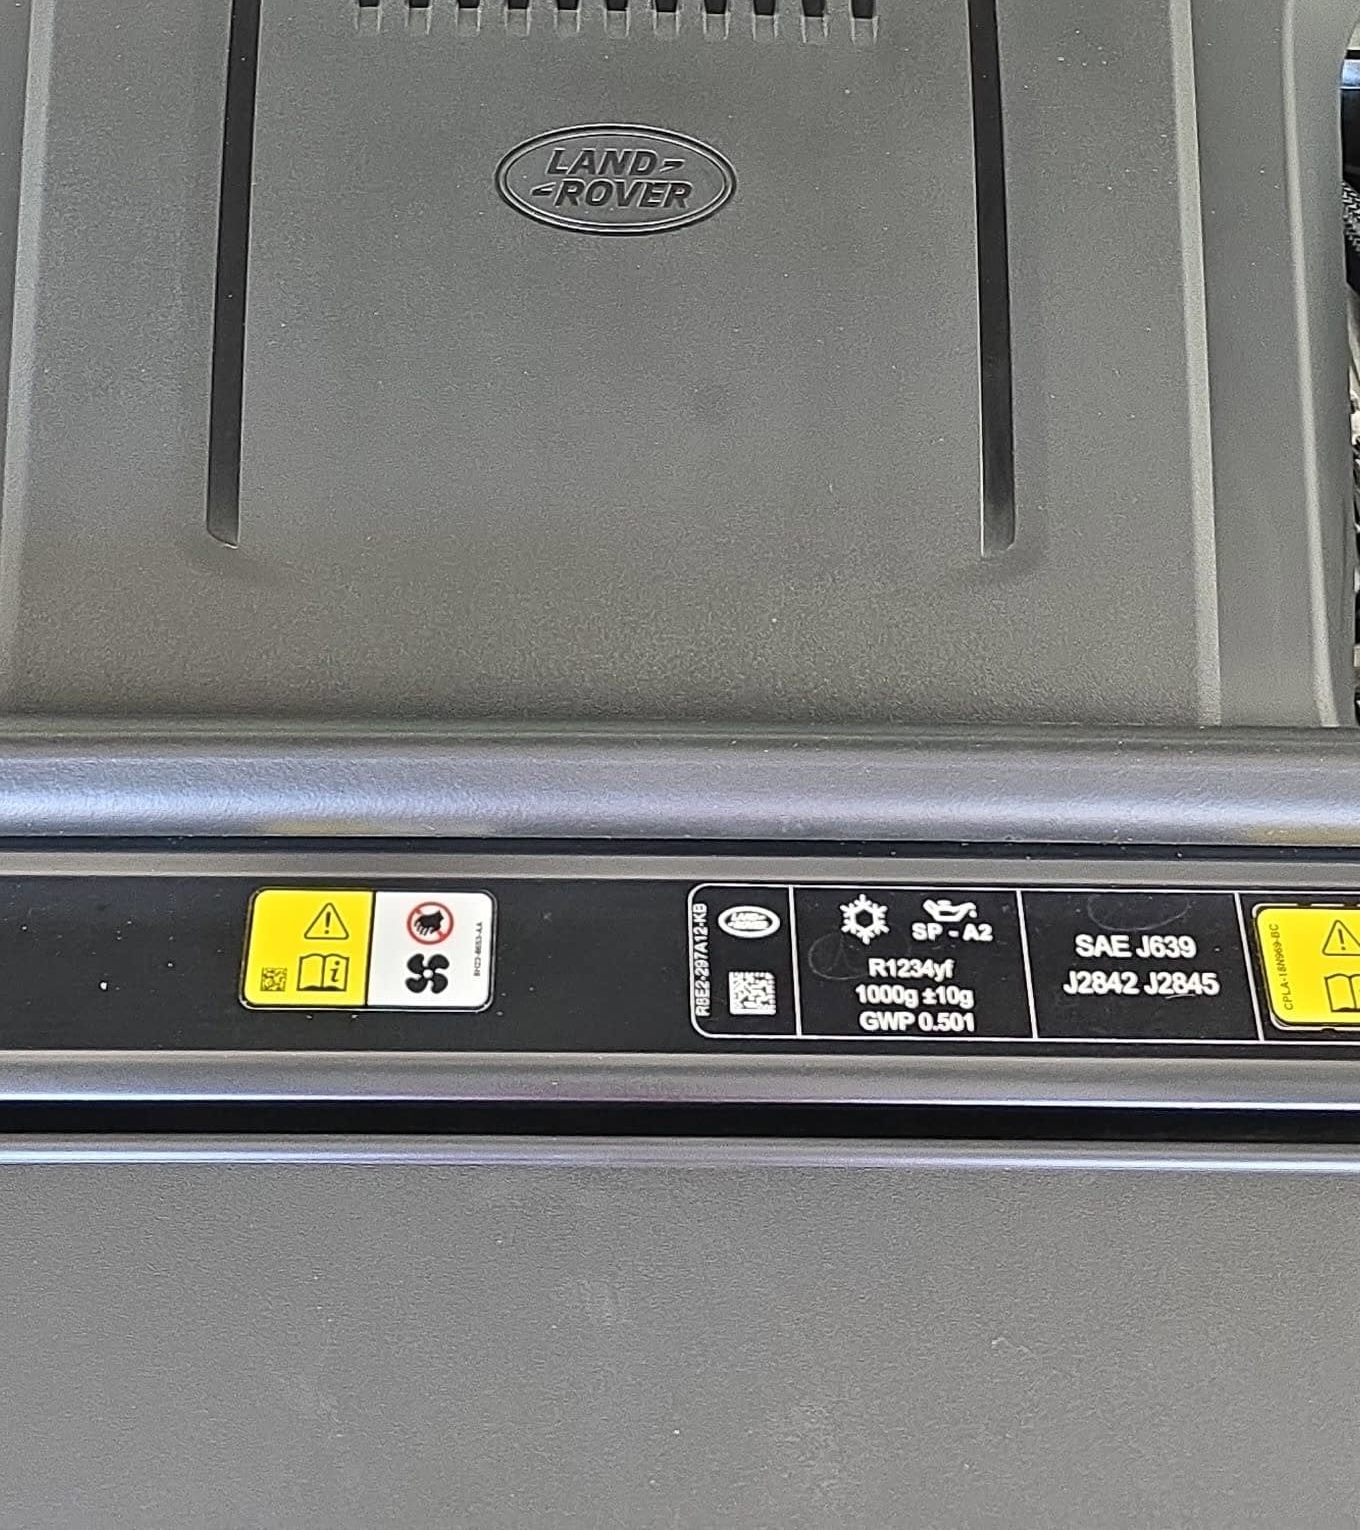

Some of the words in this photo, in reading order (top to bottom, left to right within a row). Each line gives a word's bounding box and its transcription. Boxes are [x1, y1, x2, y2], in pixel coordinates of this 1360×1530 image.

[546, 147, 658, 176] LAND
[553, 178, 693, 209] ROVER
[912, 922, 943, 941] SP
[962, 923, 994, 942] A2
[1075, 933, 1133, 958] SAE
[1136, 934, 1197, 958] J639
[868, 957, 955, 982] R1234yf
[1063, 970, 1141, 995] J2842
[1143, 971, 1221, 996] J2845
[855, 983, 919, 1009] 1000g
[921, 985, 975, 1010] ±10g
[859, 1011, 916, 1031] GWP
[918, 1011, 976, 1032] 0.501
